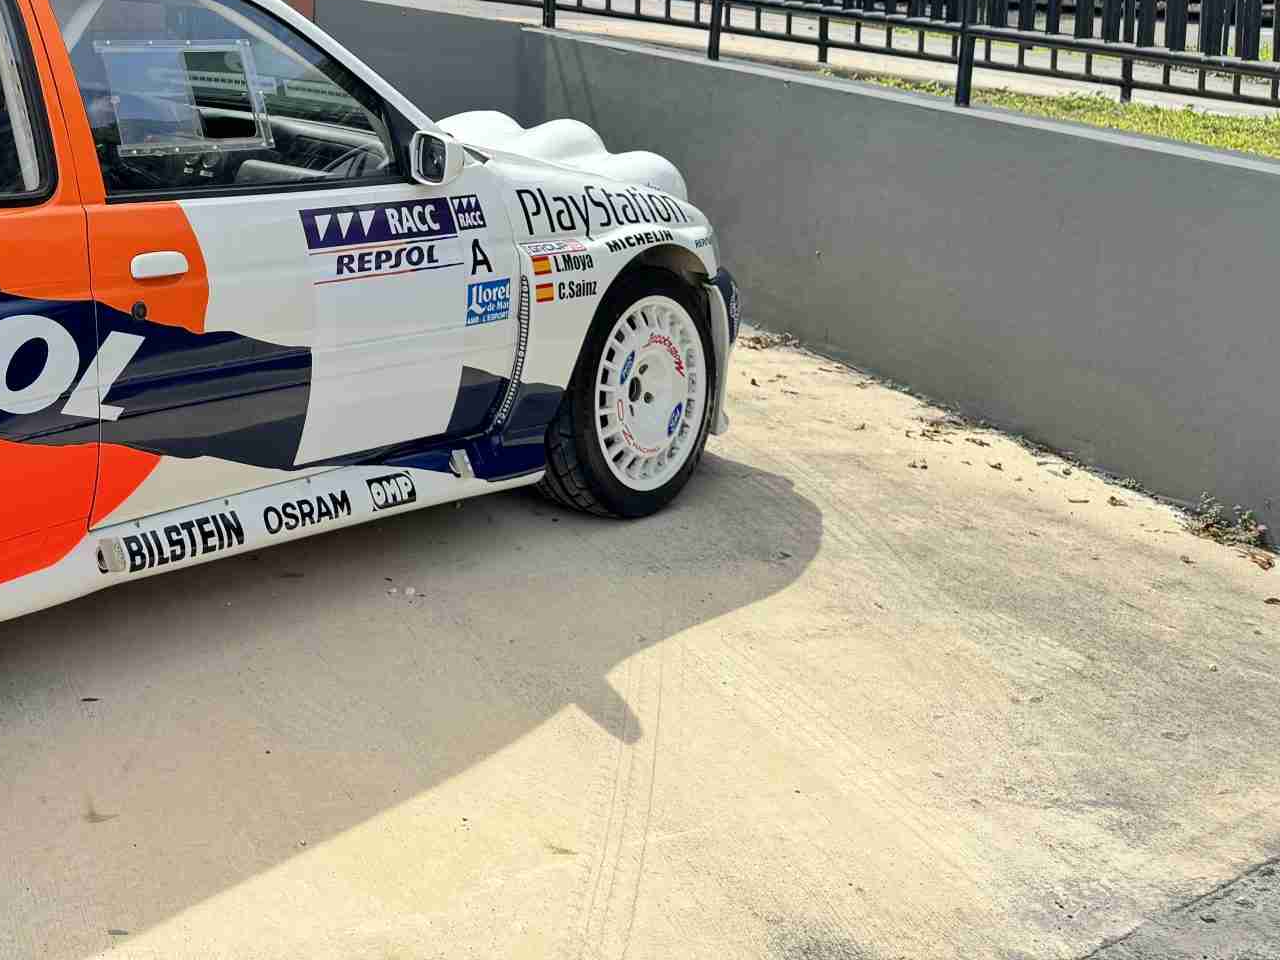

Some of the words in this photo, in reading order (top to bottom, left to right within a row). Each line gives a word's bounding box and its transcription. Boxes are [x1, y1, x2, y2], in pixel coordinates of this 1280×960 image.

[384, 204, 441, 235] RACC
[458, 211, 484, 227] RACC
[515, 185, 688, 241] PlayStation
[471, 238, 493, 275] A
[606, 229, 674, 253] MICHELIN
[335, 244, 439, 275] REPSOL
[553, 253, 595, 273] L.Moya
[558, 279, 597, 300] C.Sainz
[370, 473, 414, 509] OMP
[122, 510, 245, 573] BILSTEIN
[263, 490, 352, 535] OSRAM
